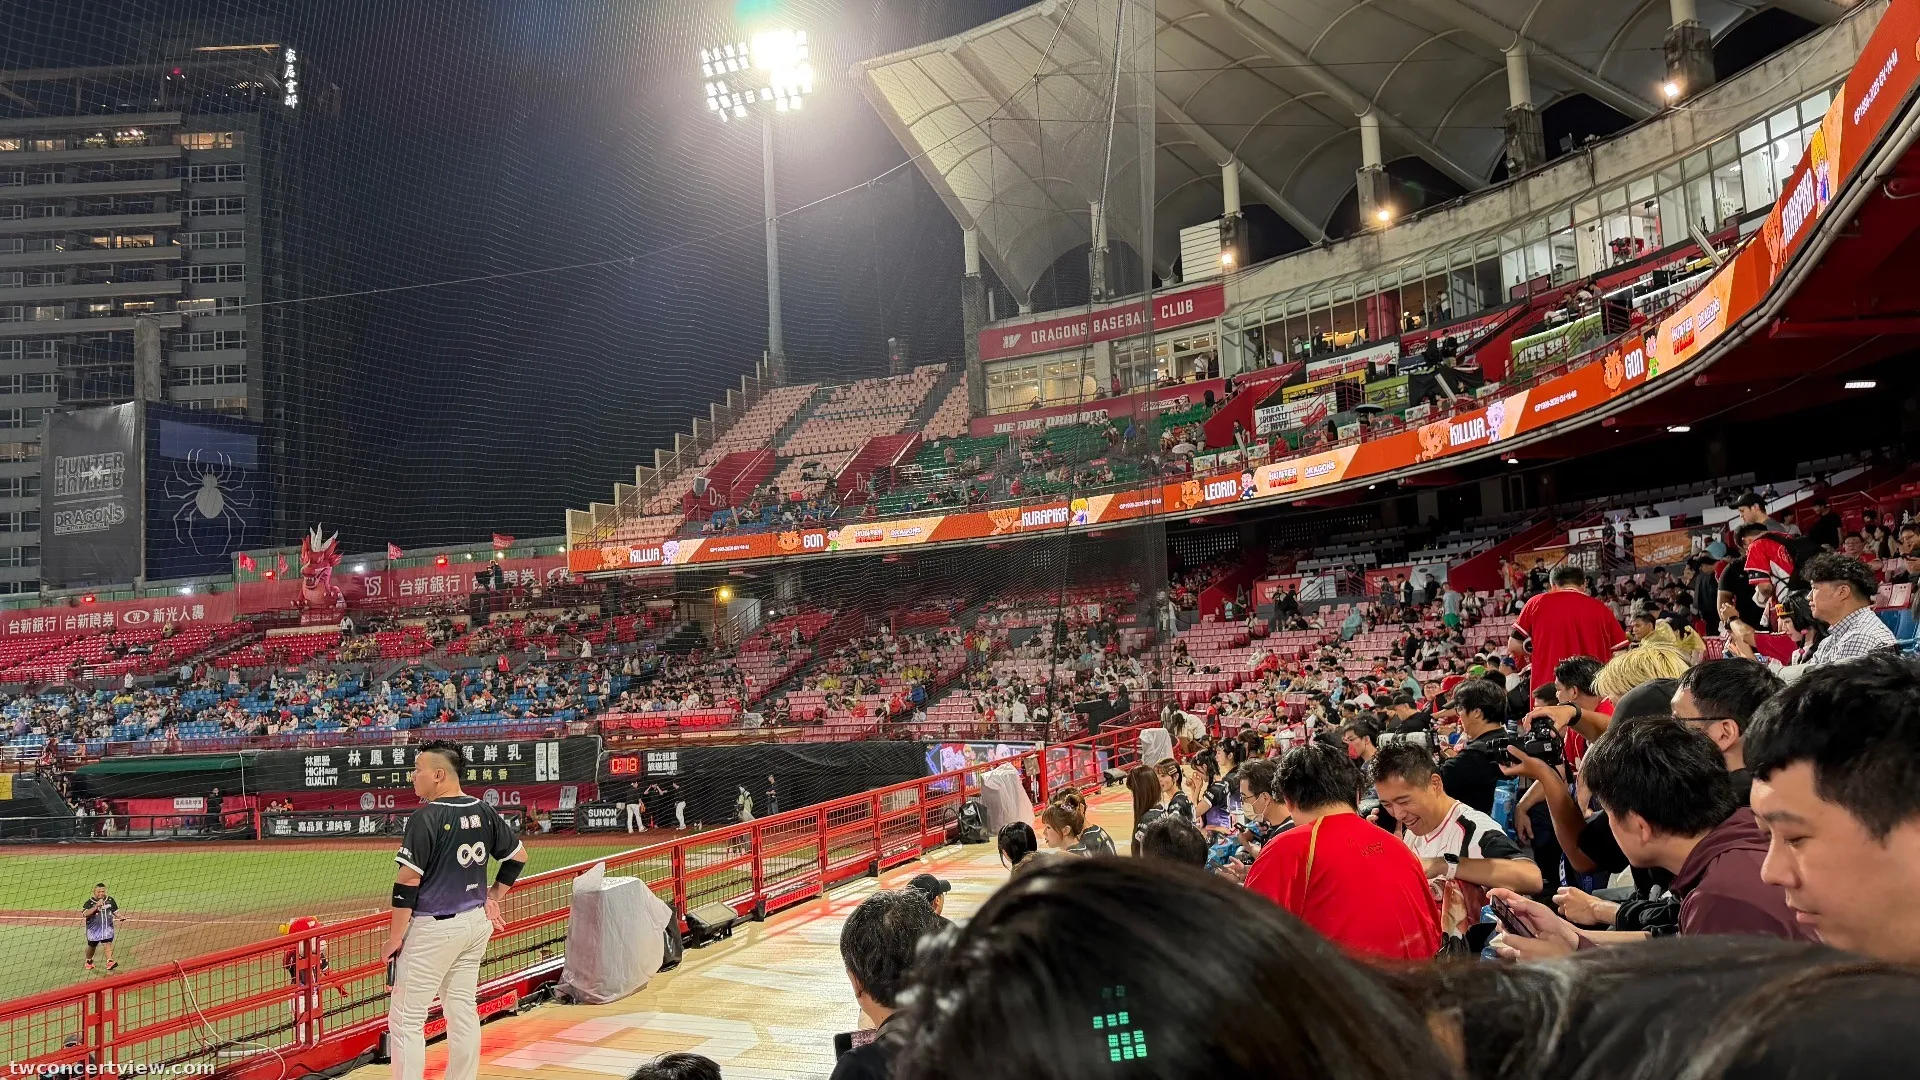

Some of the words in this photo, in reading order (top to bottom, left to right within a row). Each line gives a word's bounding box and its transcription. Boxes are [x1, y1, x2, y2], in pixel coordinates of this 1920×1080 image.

[1031, 323, 1087, 344] DRAGONS
[1161, 299, 1194, 319] CLUB
[1624, 348, 1645, 380] GON
[1259, 411, 1289, 424] YOURSELF
[1261, 405, 1285, 415] TREAT
[1450, 417, 1485, 446] KILLUA
[856, 472, 870, 494] D2
[1204, 479, 1236, 501] LEORIO
[54, 502, 124, 526] DRAGONS
[1022, 507, 1069, 527] KURAPIKA
[803, 533, 824, 548] GON
[629, 548, 660, 564] KILLUA
[399, 574, 461, 596] 台新銀行
[64, 611, 115, 631] 台新證券
[153, 605, 205, 623] 新光人壽
[8, 616, 57, 635] 台新銀行
[348, 748, 405, 767] 林鳳營
[305, 767, 325, 777] HIGH
[305, 776, 338, 787] QUALITY
[378, 795, 395, 808] LG
[502, 791, 521, 806] LG
[588, 808, 617, 817] SUNON
